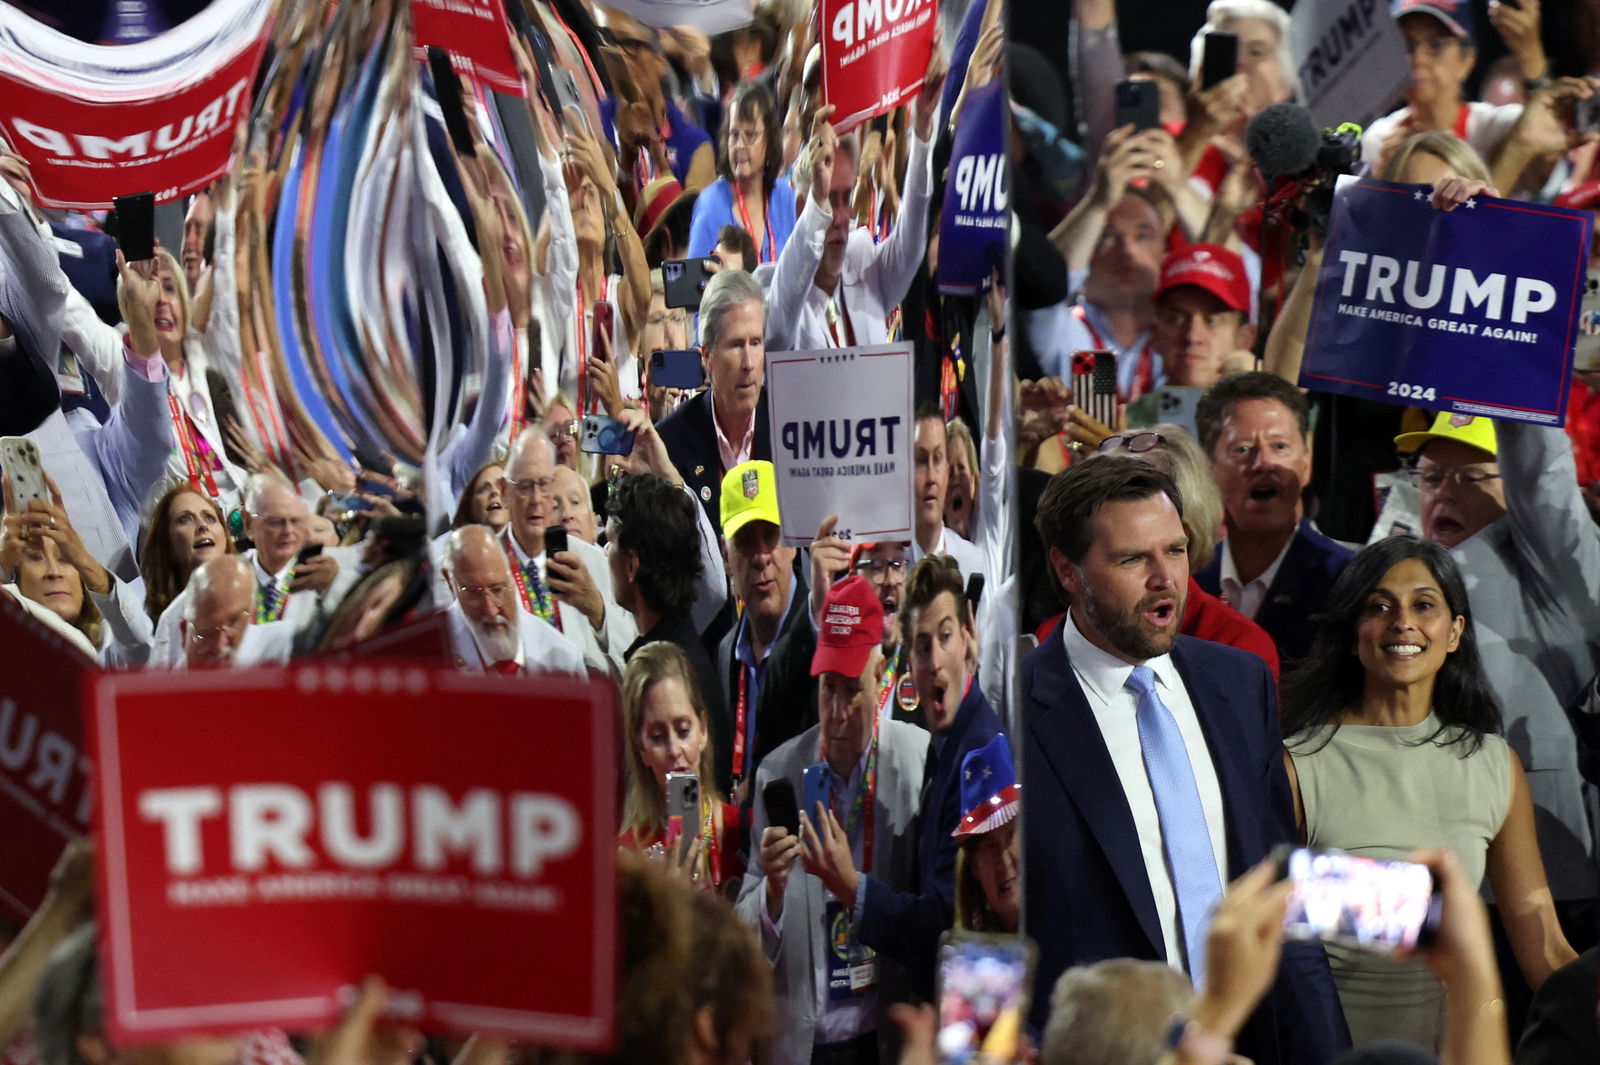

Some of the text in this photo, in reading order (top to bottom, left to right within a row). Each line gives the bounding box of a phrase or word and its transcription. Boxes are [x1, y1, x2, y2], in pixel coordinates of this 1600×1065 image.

[1339, 250, 1557, 324] TRUMP
[1338, 303, 1538, 344] MAKE AMERICA GREAT AGAIN!
[1387, 381, 1436, 401] 2024
[138, 782, 583, 877] TRUMP
